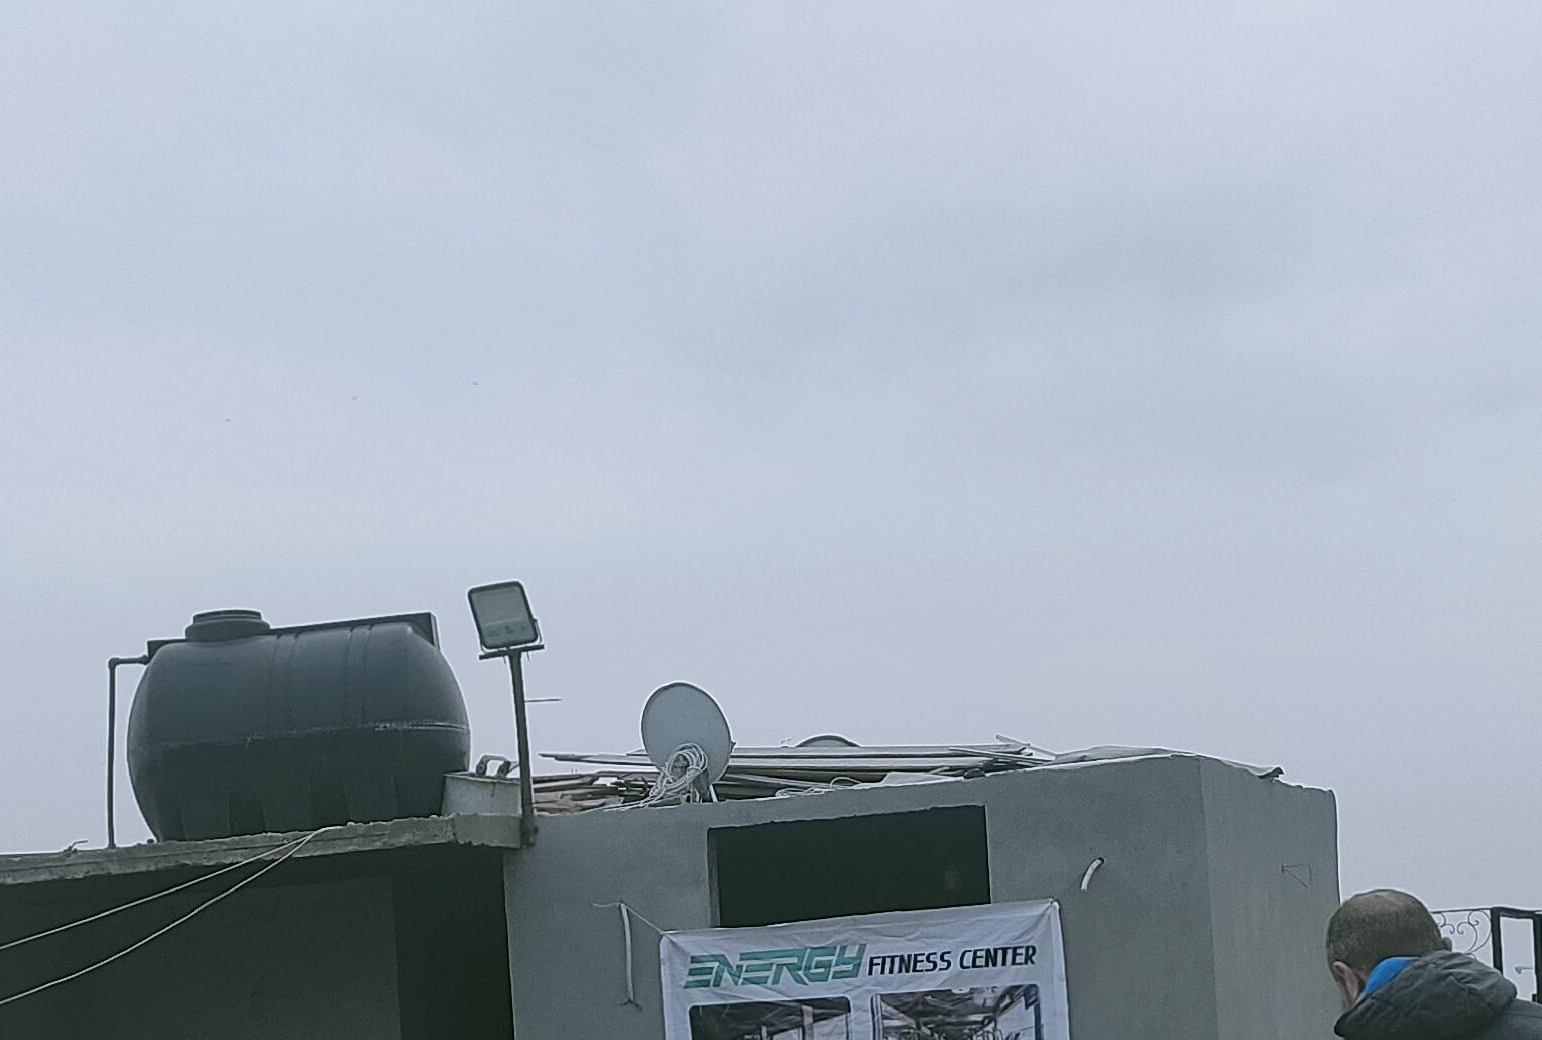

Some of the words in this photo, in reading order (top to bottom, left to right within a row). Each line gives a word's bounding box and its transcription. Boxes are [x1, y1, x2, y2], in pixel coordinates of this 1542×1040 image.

[683, 943, 867, 989] ENERGY
[867, 950, 953, 976] FITNESS
[959, 944, 1037, 969] CENTER
